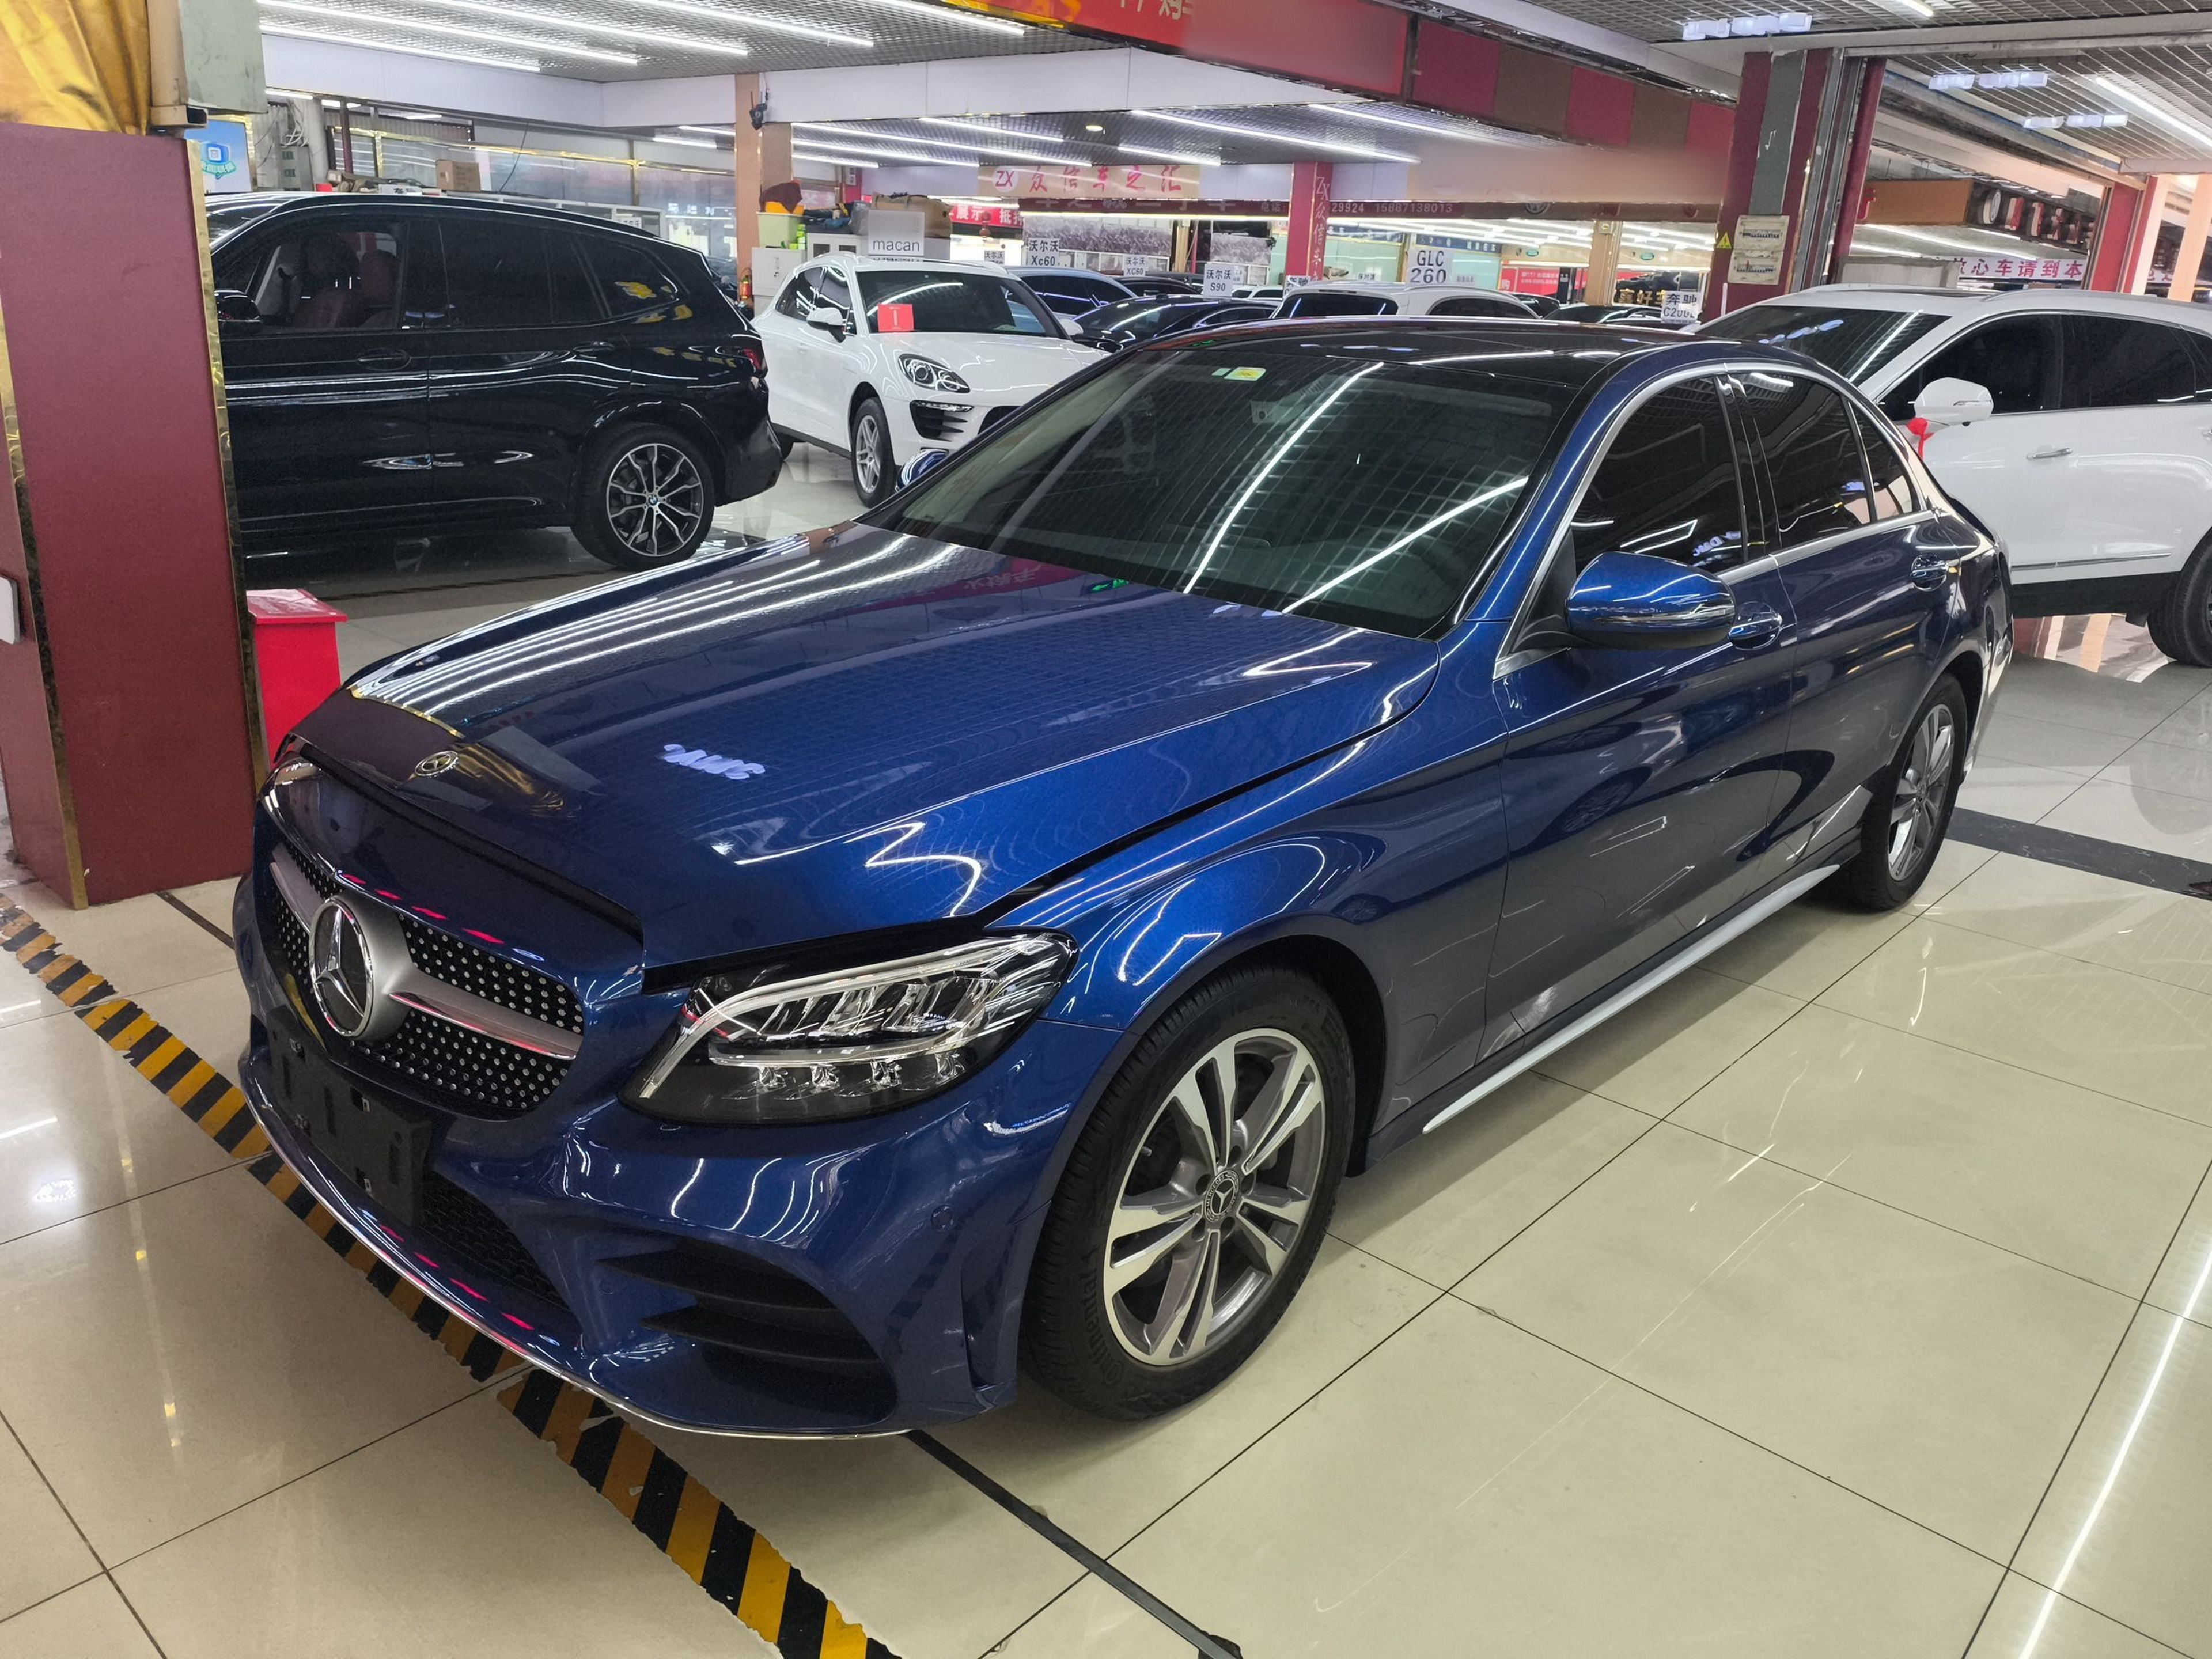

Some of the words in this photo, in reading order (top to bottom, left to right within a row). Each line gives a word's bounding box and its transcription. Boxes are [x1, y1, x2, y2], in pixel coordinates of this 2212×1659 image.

[995, 171, 1013, 187] ZX
[873, 239, 920, 252] macan
[1029, 239, 1059, 252] 沃尔沃
[984, 250, 1003, 259] 沃尔沃
[1417, 249, 1444, 266] GLC
[1126, 256, 1145, 266] 沃尔沃
[1206, 269, 1231, 280] 沃尔沃
[1410, 267, 1447, 284] 260
[1210, 282, 1226, 291] S90
[1666, 293, 1697, 305] 奔驰
